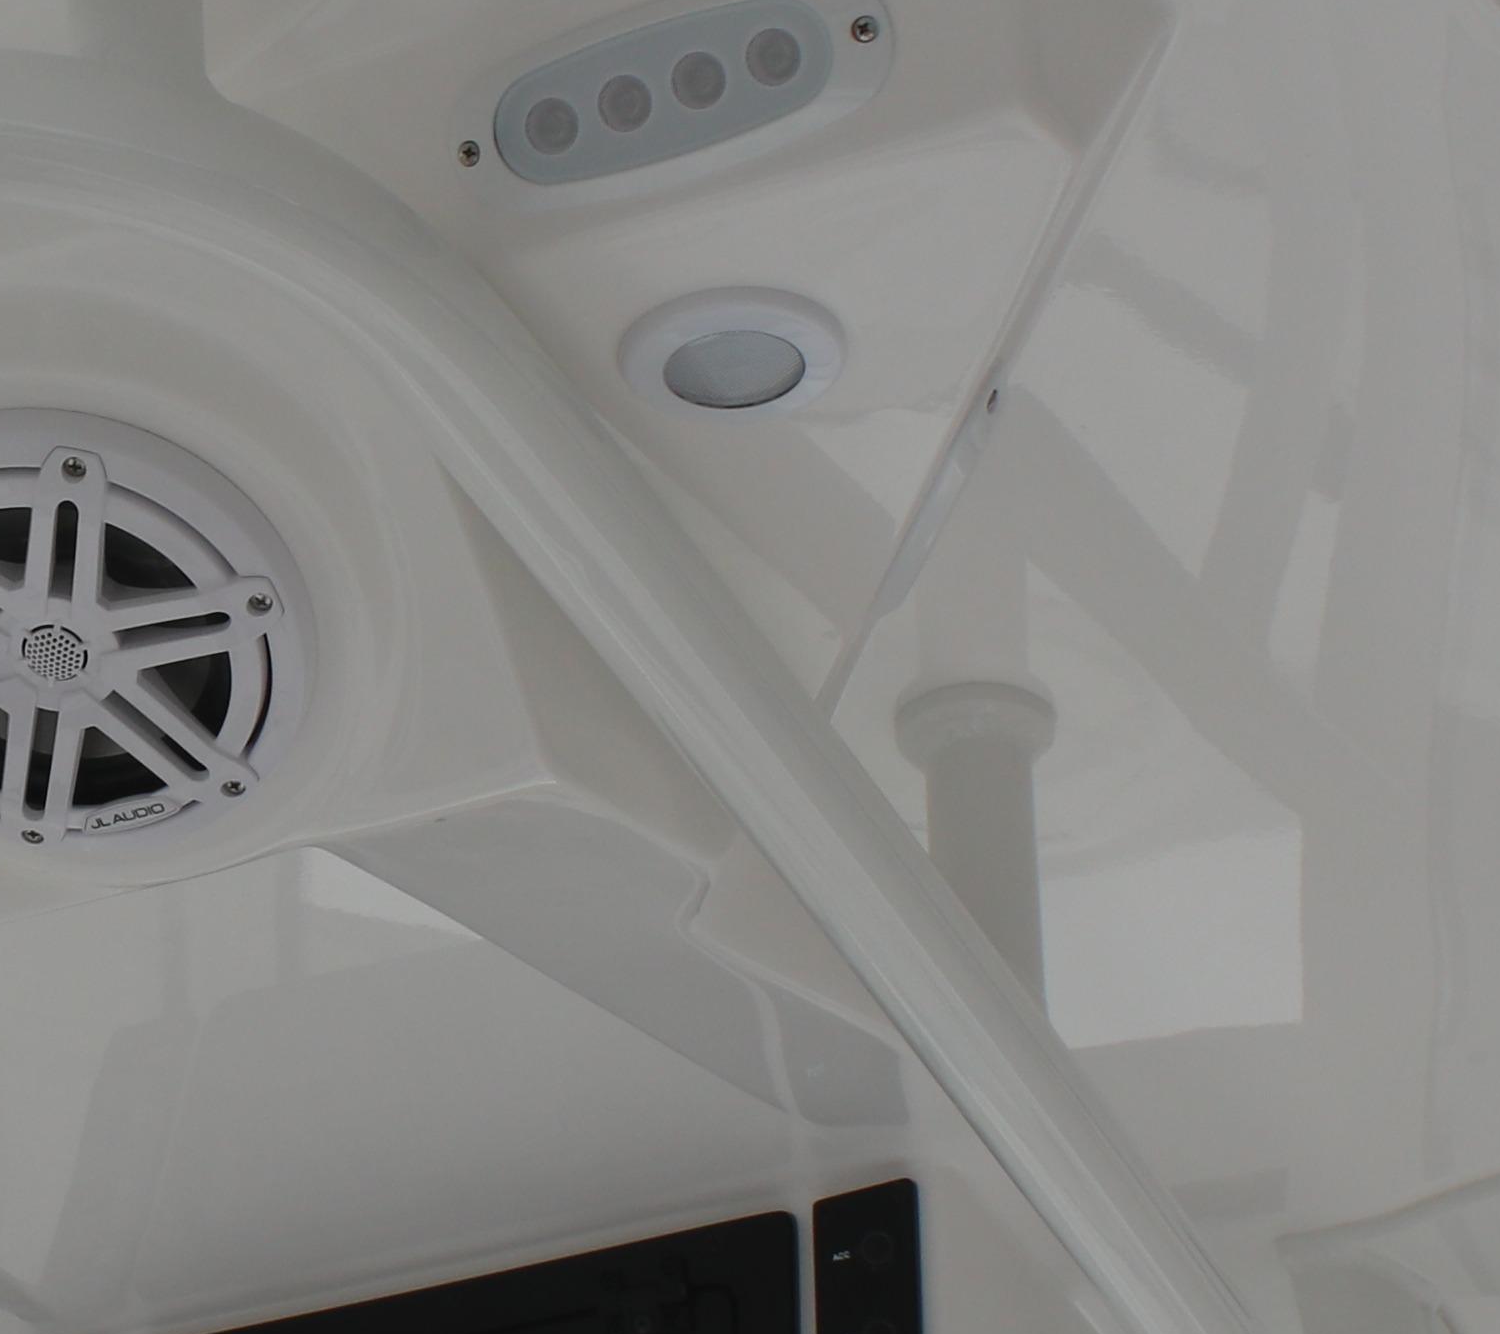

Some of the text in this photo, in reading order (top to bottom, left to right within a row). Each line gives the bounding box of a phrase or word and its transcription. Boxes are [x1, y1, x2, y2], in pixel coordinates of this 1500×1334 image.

[91, 803, 165, 829] JL AUDIO
[833, 1251, 851, 1261] ACC
